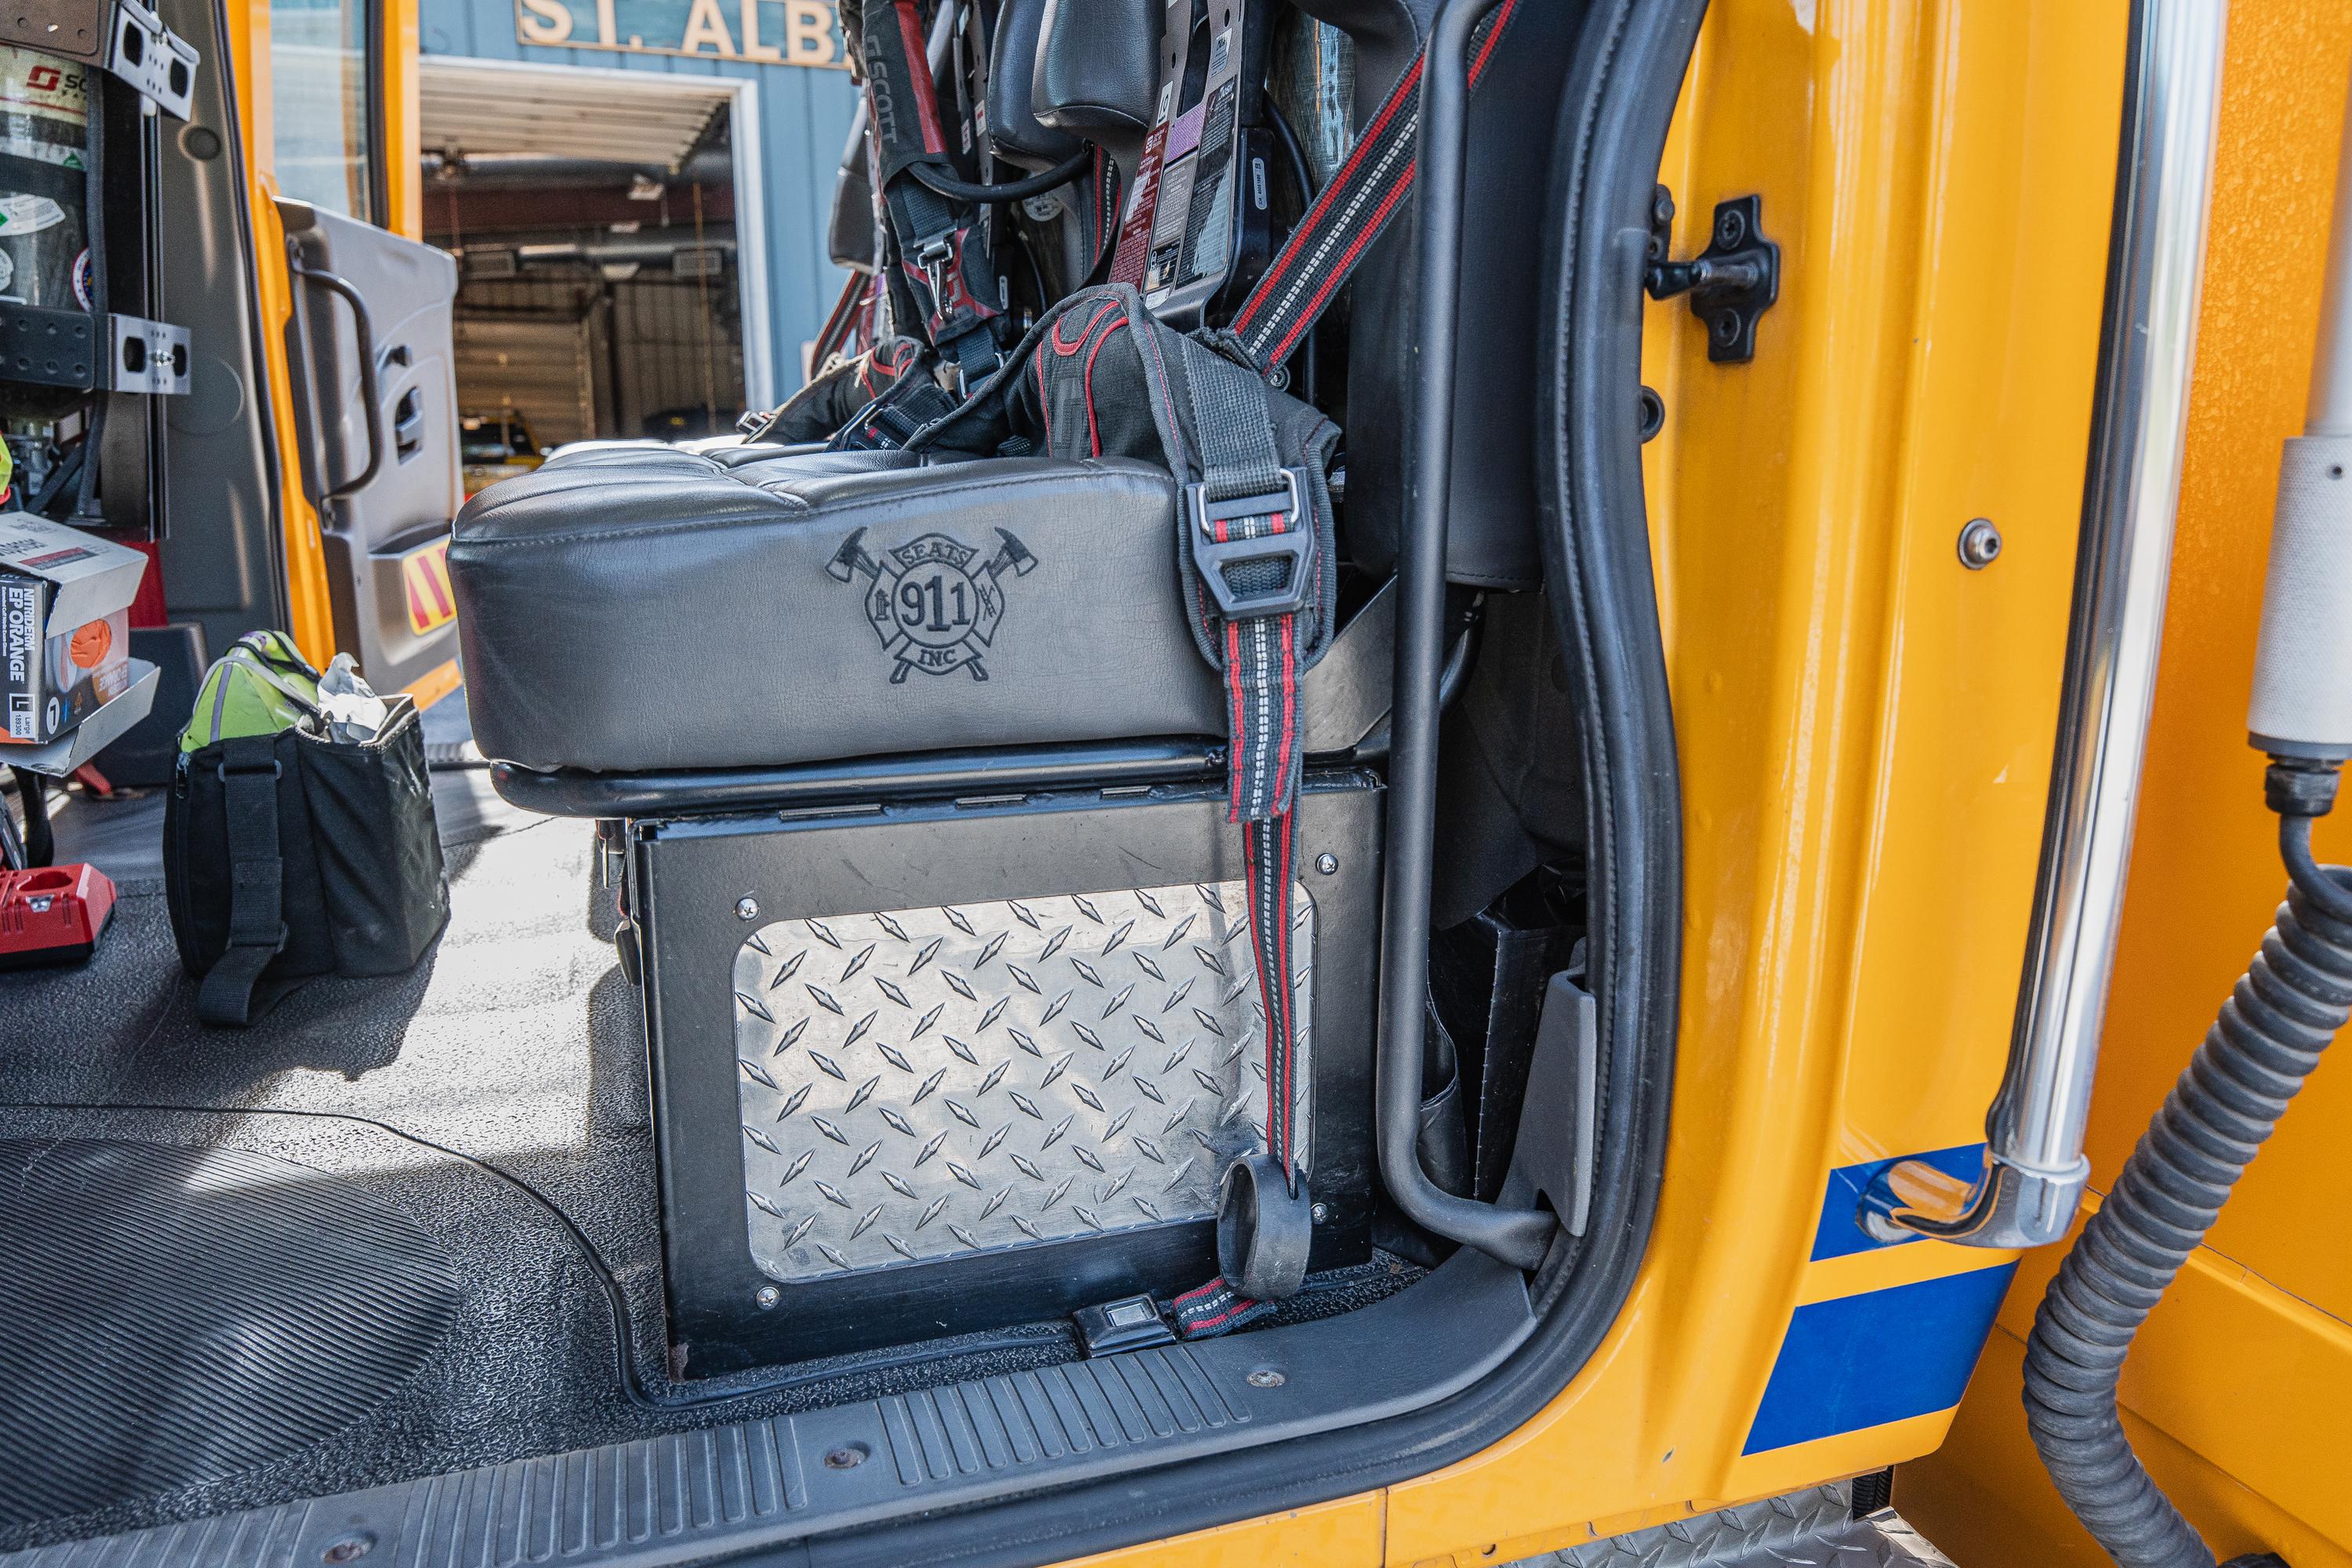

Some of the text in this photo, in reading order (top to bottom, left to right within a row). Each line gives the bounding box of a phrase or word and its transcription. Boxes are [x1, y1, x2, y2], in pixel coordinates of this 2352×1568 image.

[869, 62, 897, 143] SCOTT
[902, 542, 968, 564] SEATS
[24, 588, 35, 652] NITRIDERM
[901, 575, 971, 631] 911
[9, 587, 25, 682] EP ORANGE
[918, 648, 957, 666] INC
